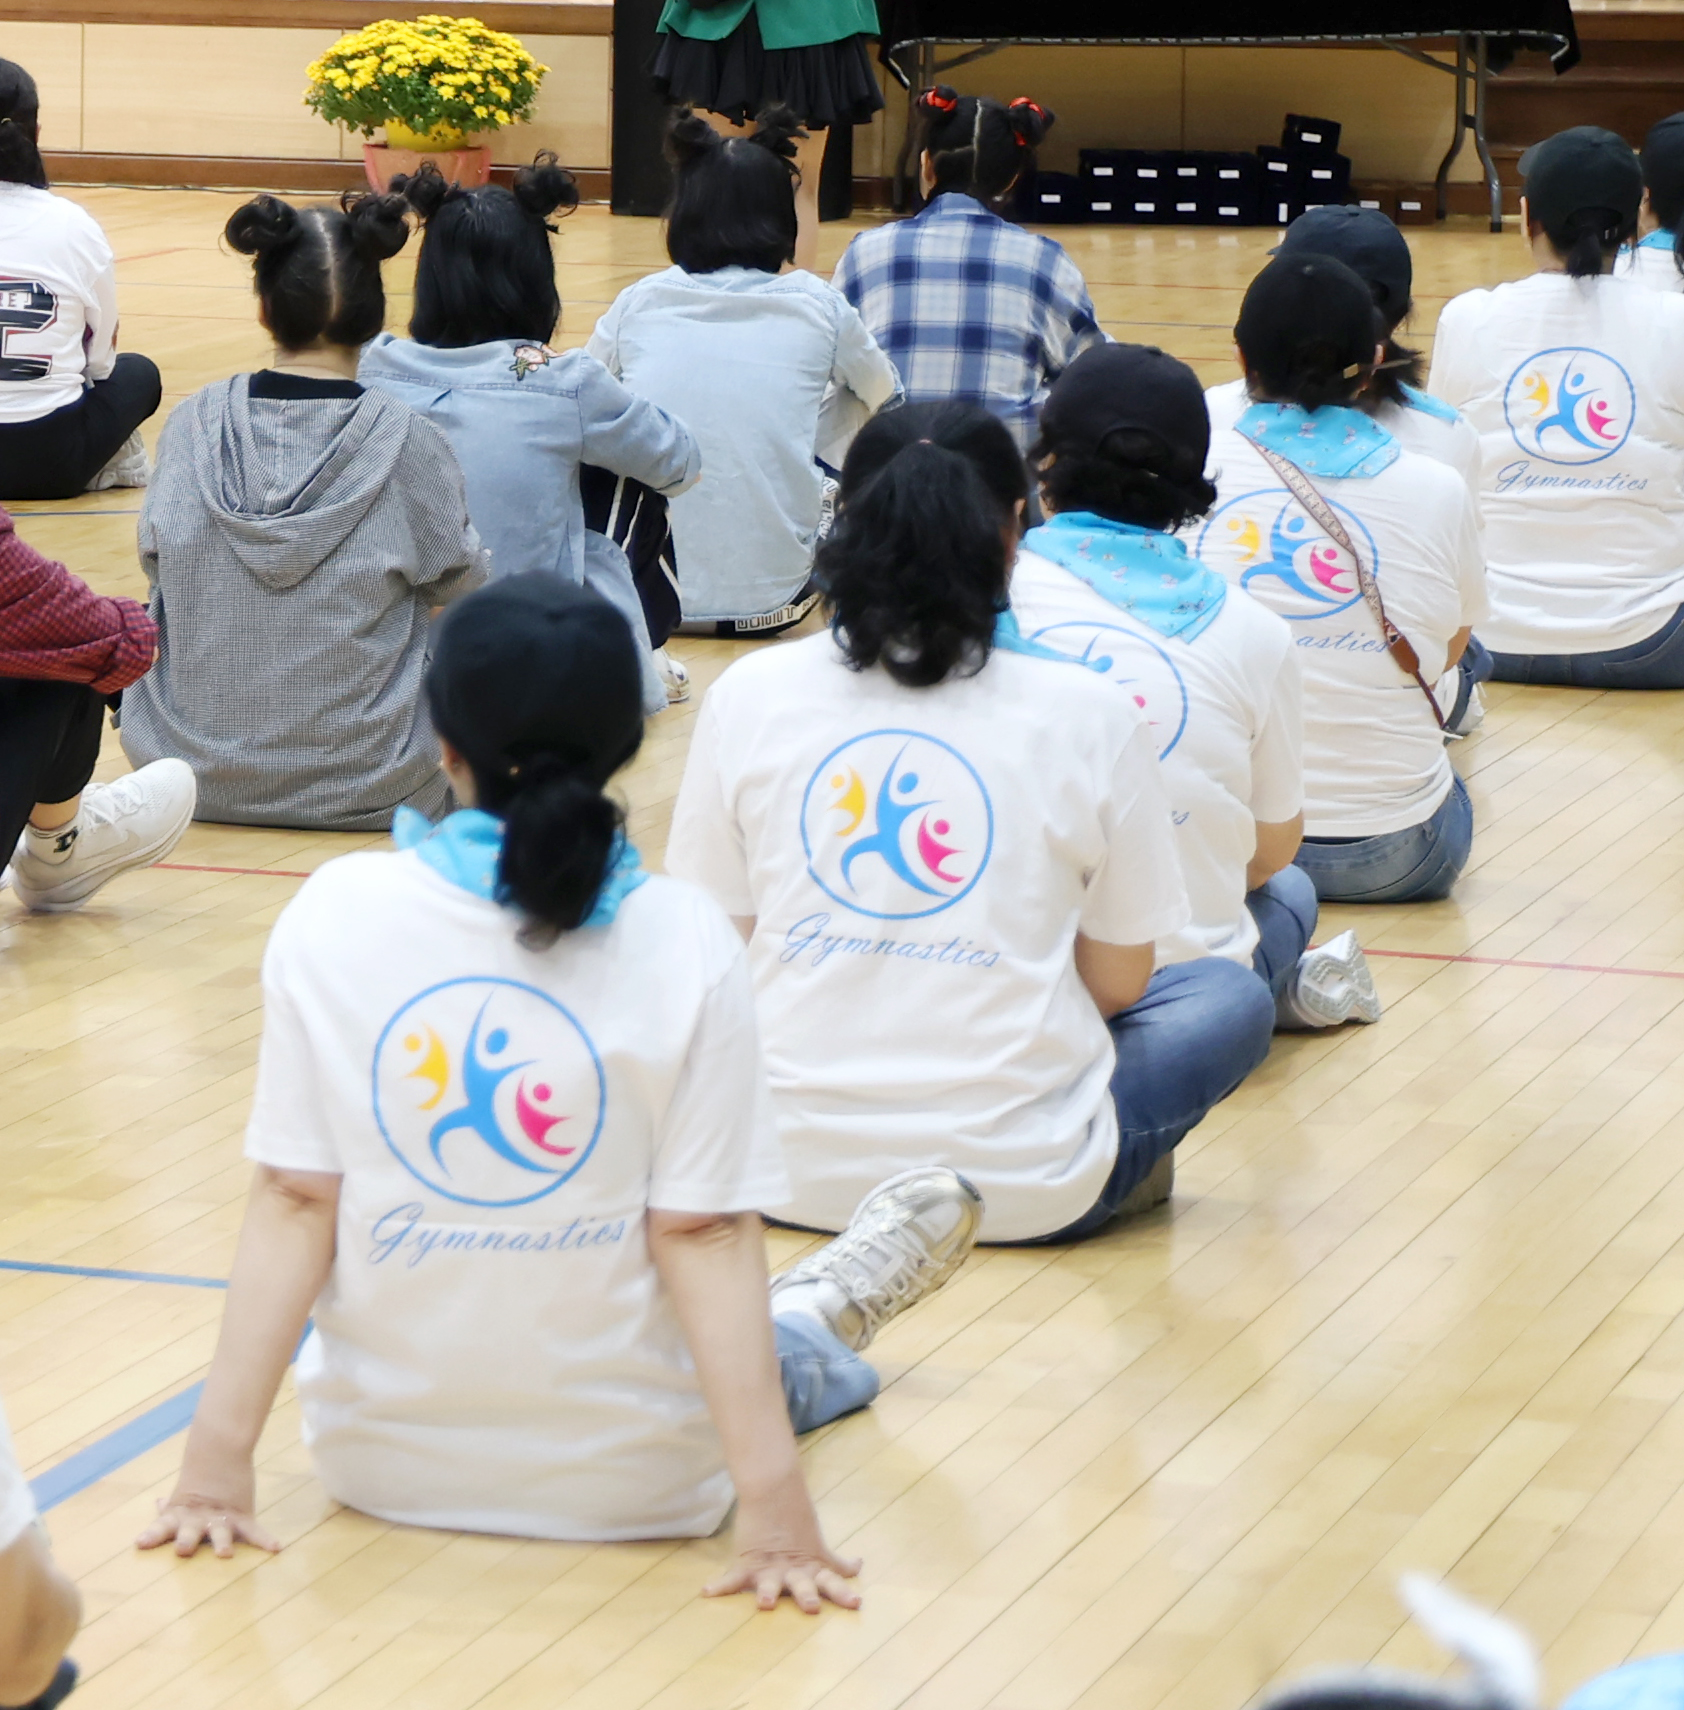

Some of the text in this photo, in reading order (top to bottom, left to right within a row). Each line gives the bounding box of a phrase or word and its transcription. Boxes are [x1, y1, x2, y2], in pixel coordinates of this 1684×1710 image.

[1496, 459, 1649, 494] Gymnastics
[1296, 630, 1390, 654] astics
[778, 913, 1003, 970] Gymnastics
[367, 1201, 628, 1269] Gymnastics
